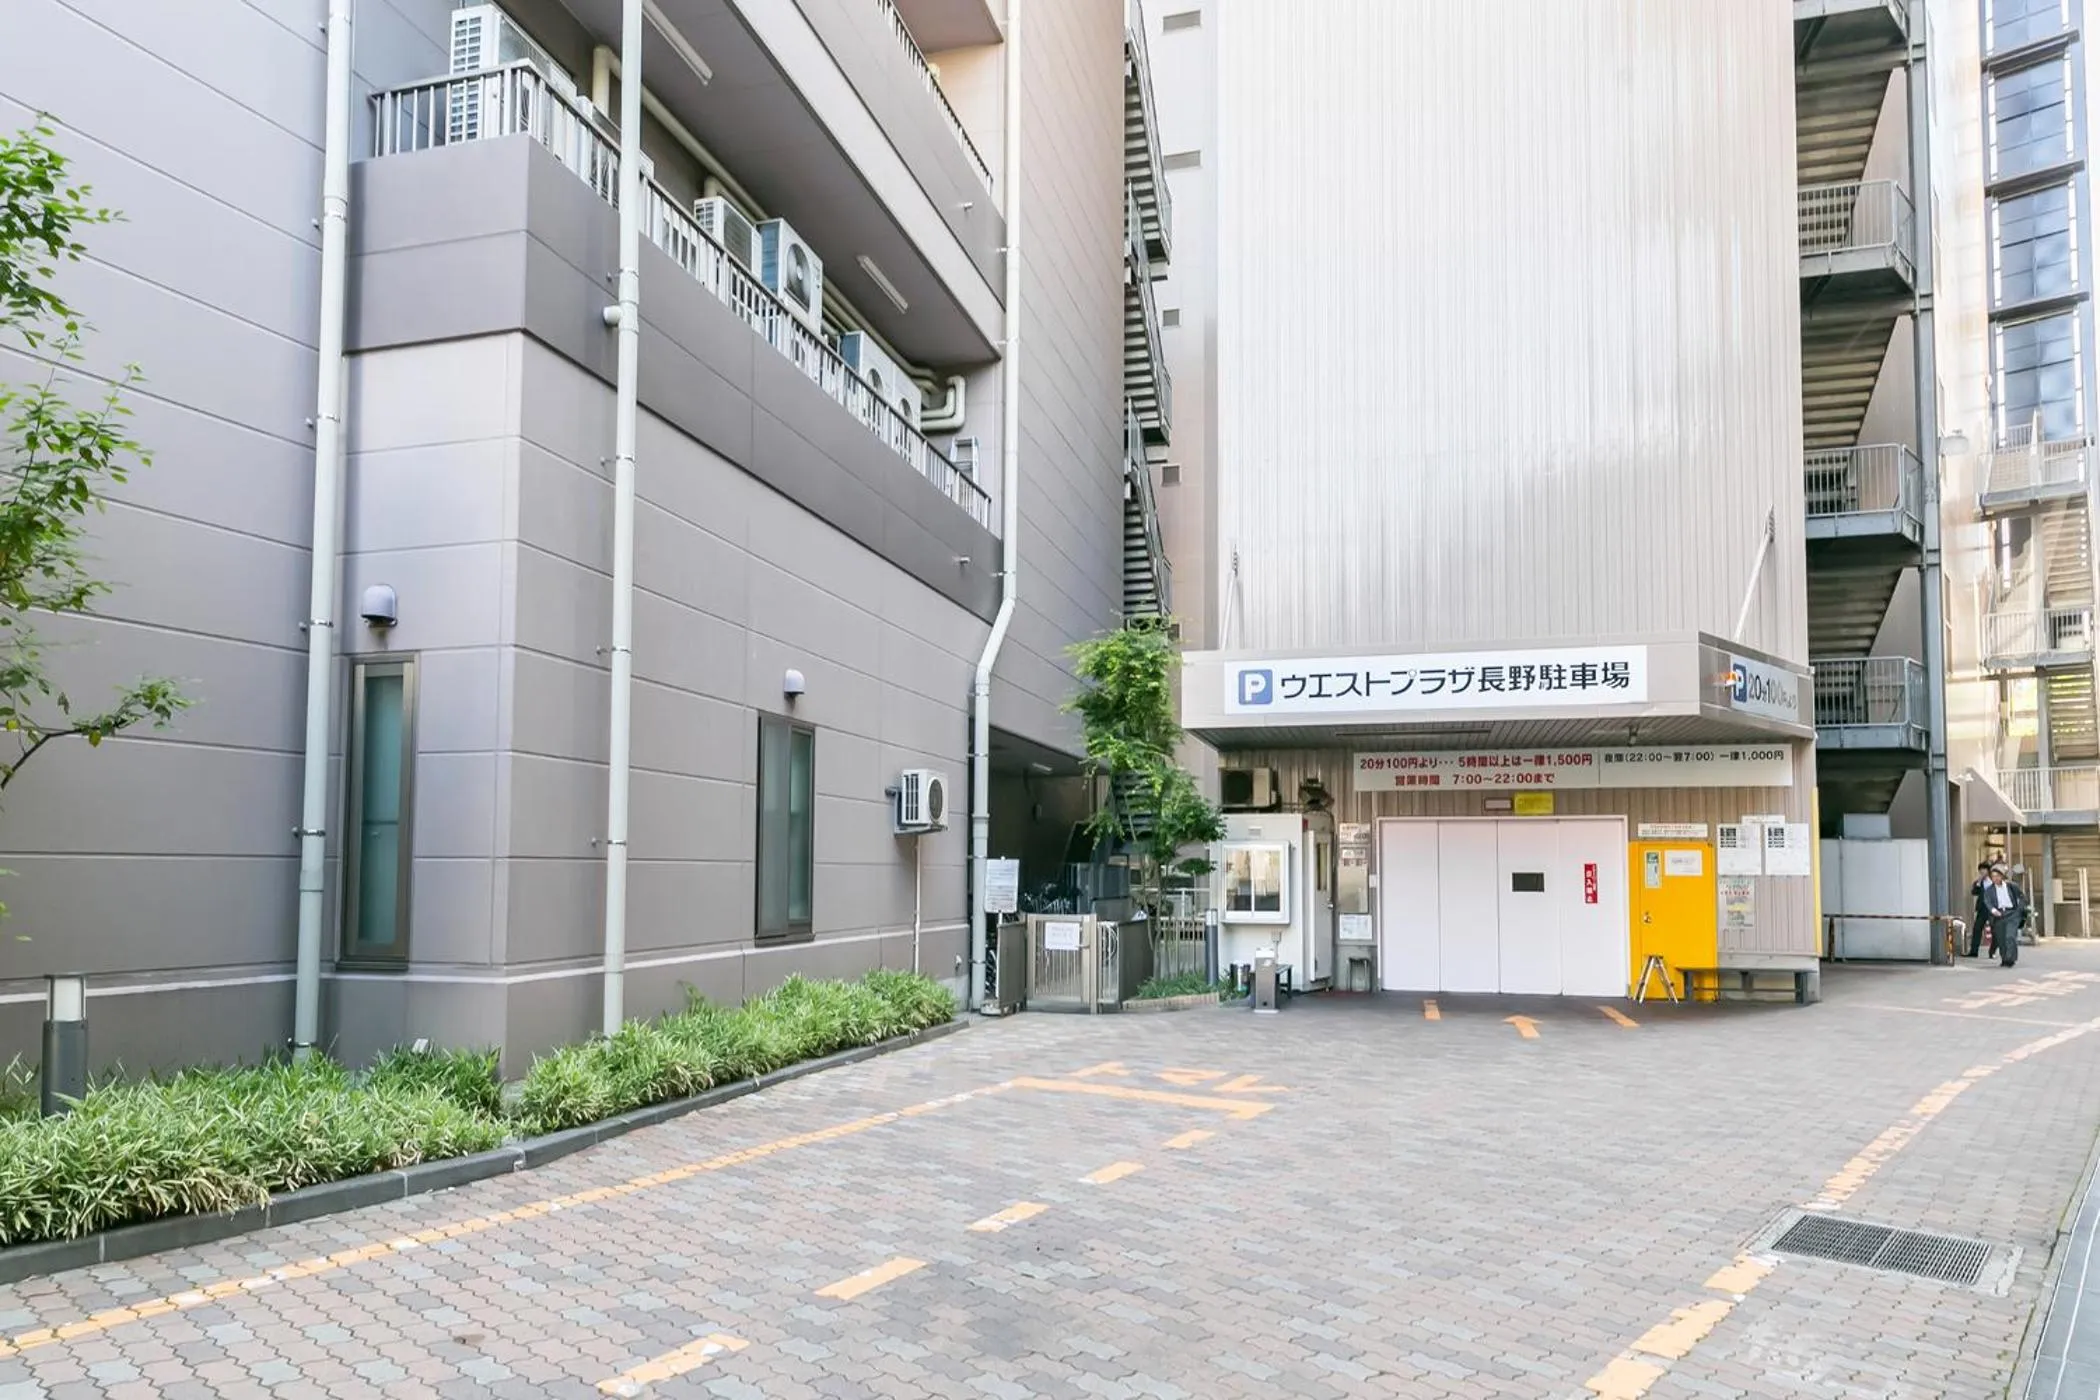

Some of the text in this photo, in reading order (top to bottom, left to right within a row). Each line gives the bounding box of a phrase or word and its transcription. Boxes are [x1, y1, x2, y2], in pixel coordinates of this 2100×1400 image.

[1242, 661, 1629, 704] P ウエストプラザ長野駐車場
